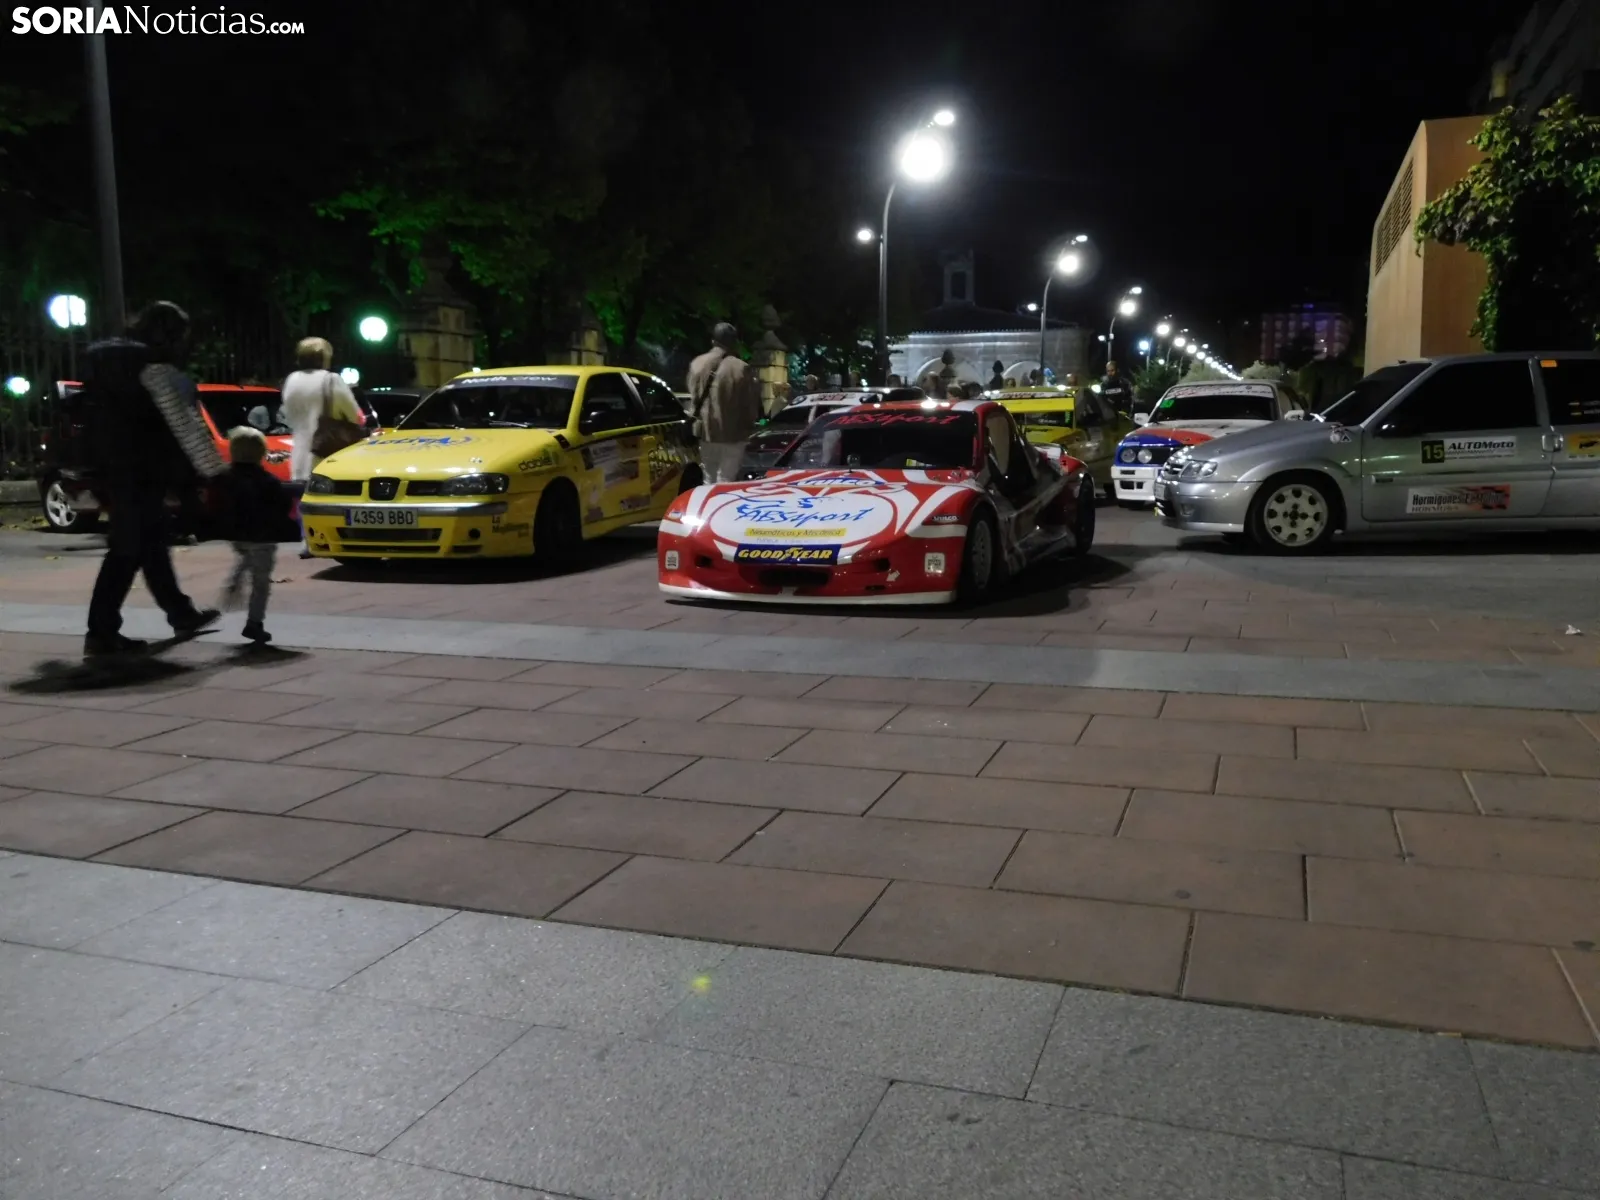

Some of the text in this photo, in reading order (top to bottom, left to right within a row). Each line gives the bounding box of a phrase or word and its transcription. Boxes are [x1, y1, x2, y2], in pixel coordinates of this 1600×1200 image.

[1423, 444, 1444, 460] 15
[354, 510, 384, 525] 4359
[737, 547, 833, 561] GOODYEAR
